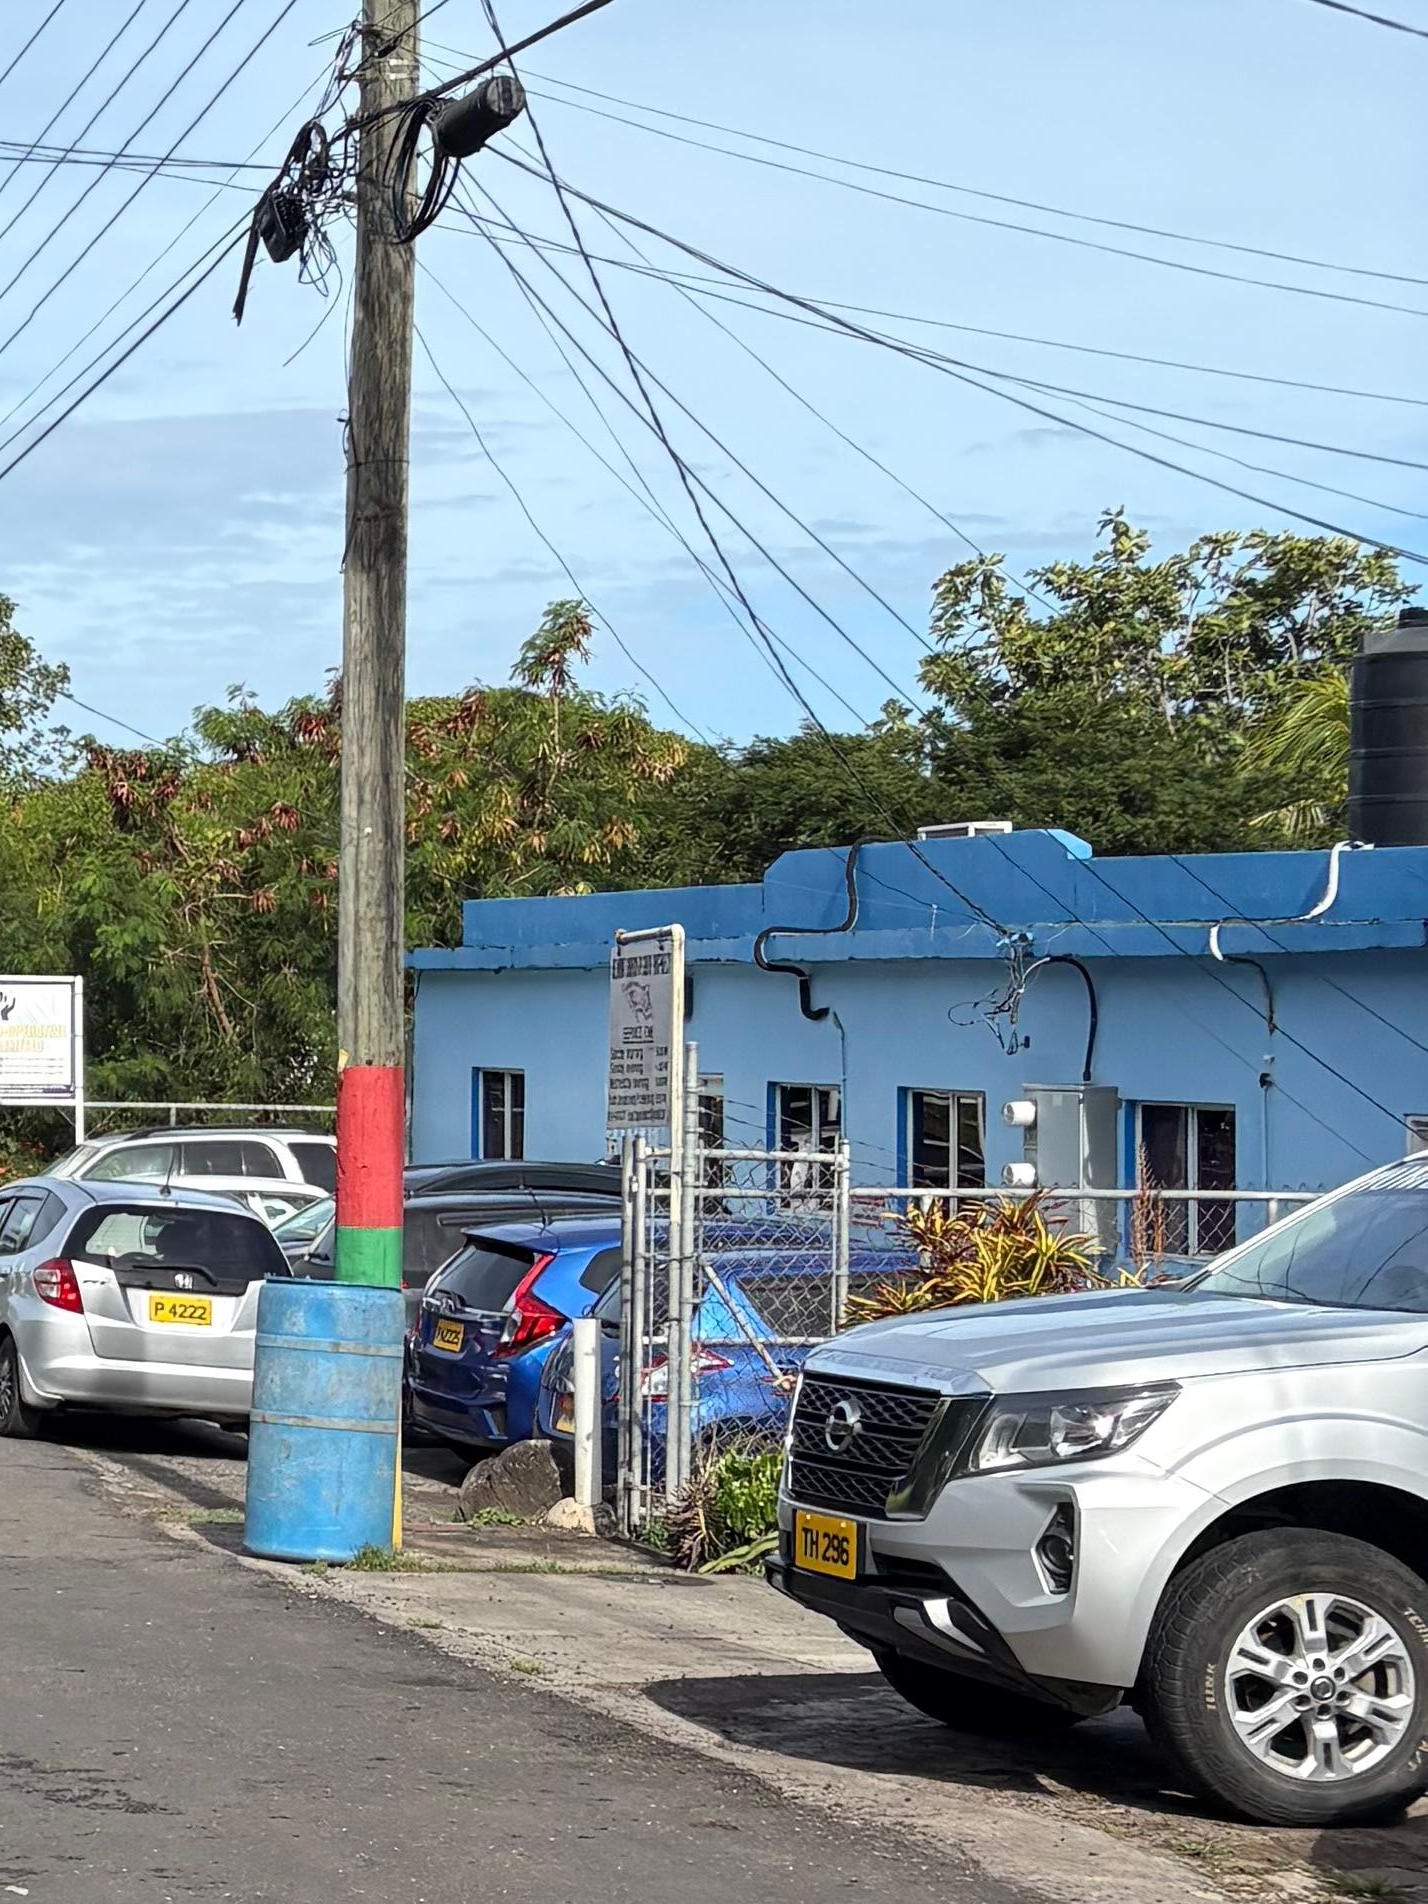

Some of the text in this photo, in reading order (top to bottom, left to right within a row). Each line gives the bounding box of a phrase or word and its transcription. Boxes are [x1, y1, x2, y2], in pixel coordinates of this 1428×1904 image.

[155, 1302, 207, 1320] P 4222
[802, 1527, 849, 1565] TH 296
